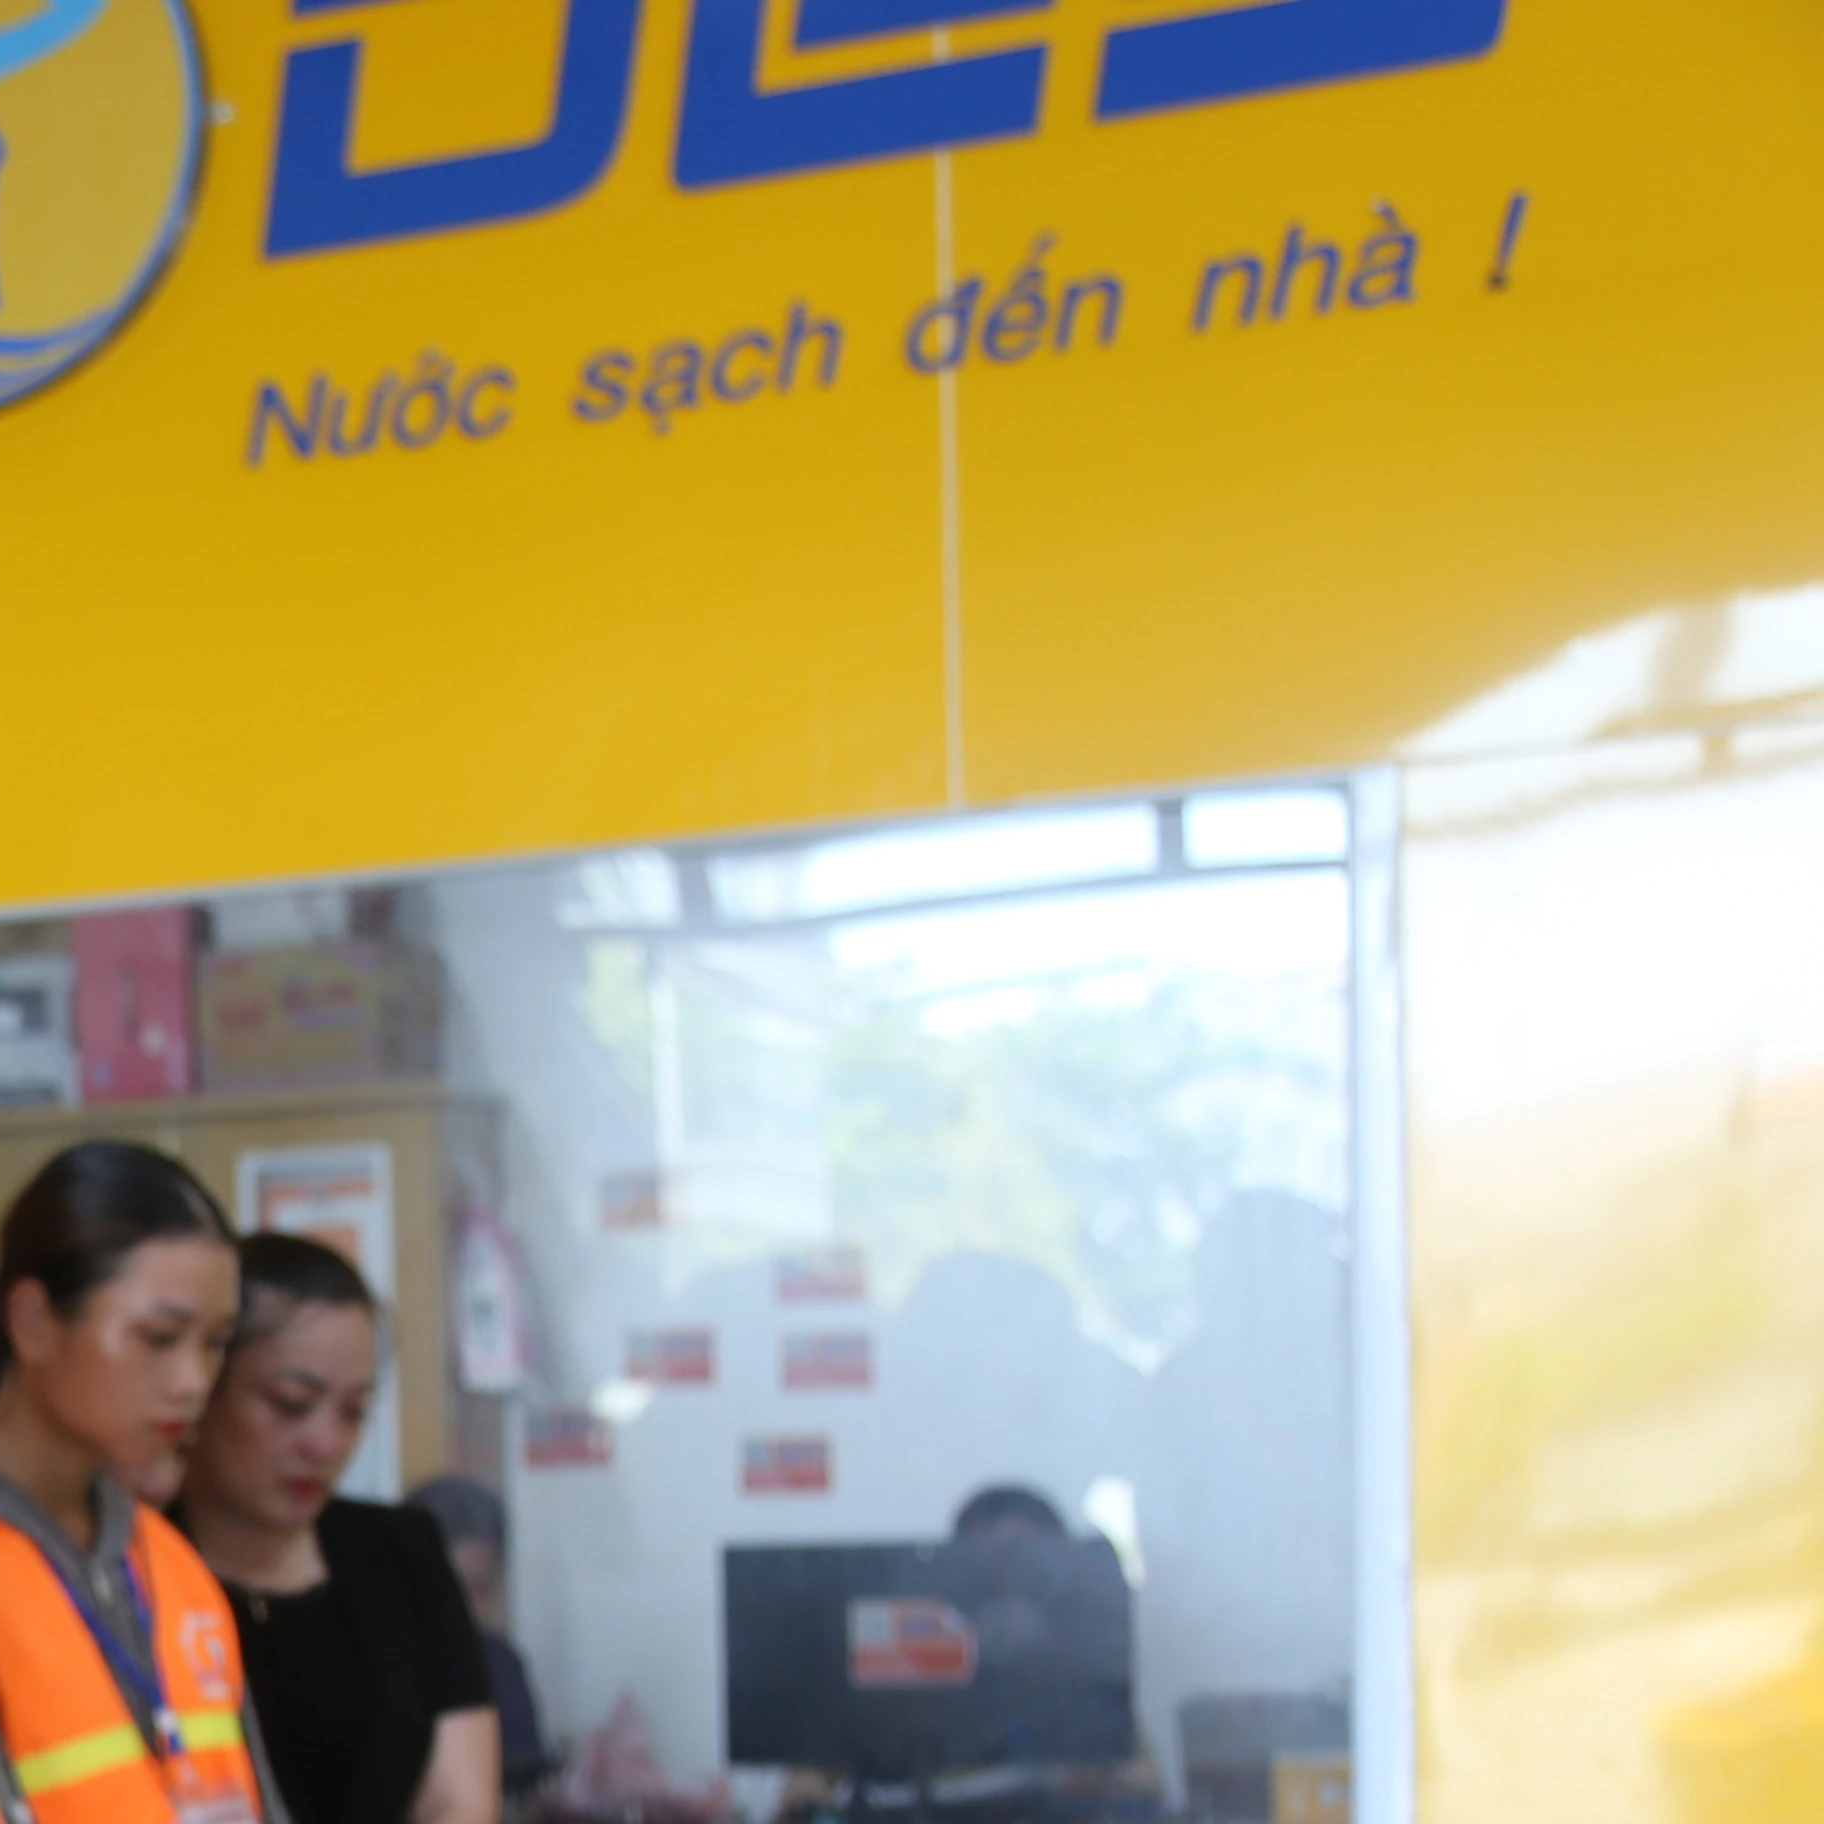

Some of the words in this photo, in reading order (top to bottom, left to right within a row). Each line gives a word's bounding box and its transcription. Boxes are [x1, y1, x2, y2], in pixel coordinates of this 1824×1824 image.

[571, 300, 844, 434] sạch
[903, 233, 1125, 377] đến
[1191, 202, 1421, 332] nhà
[1486, 191, 1530, 292] !
